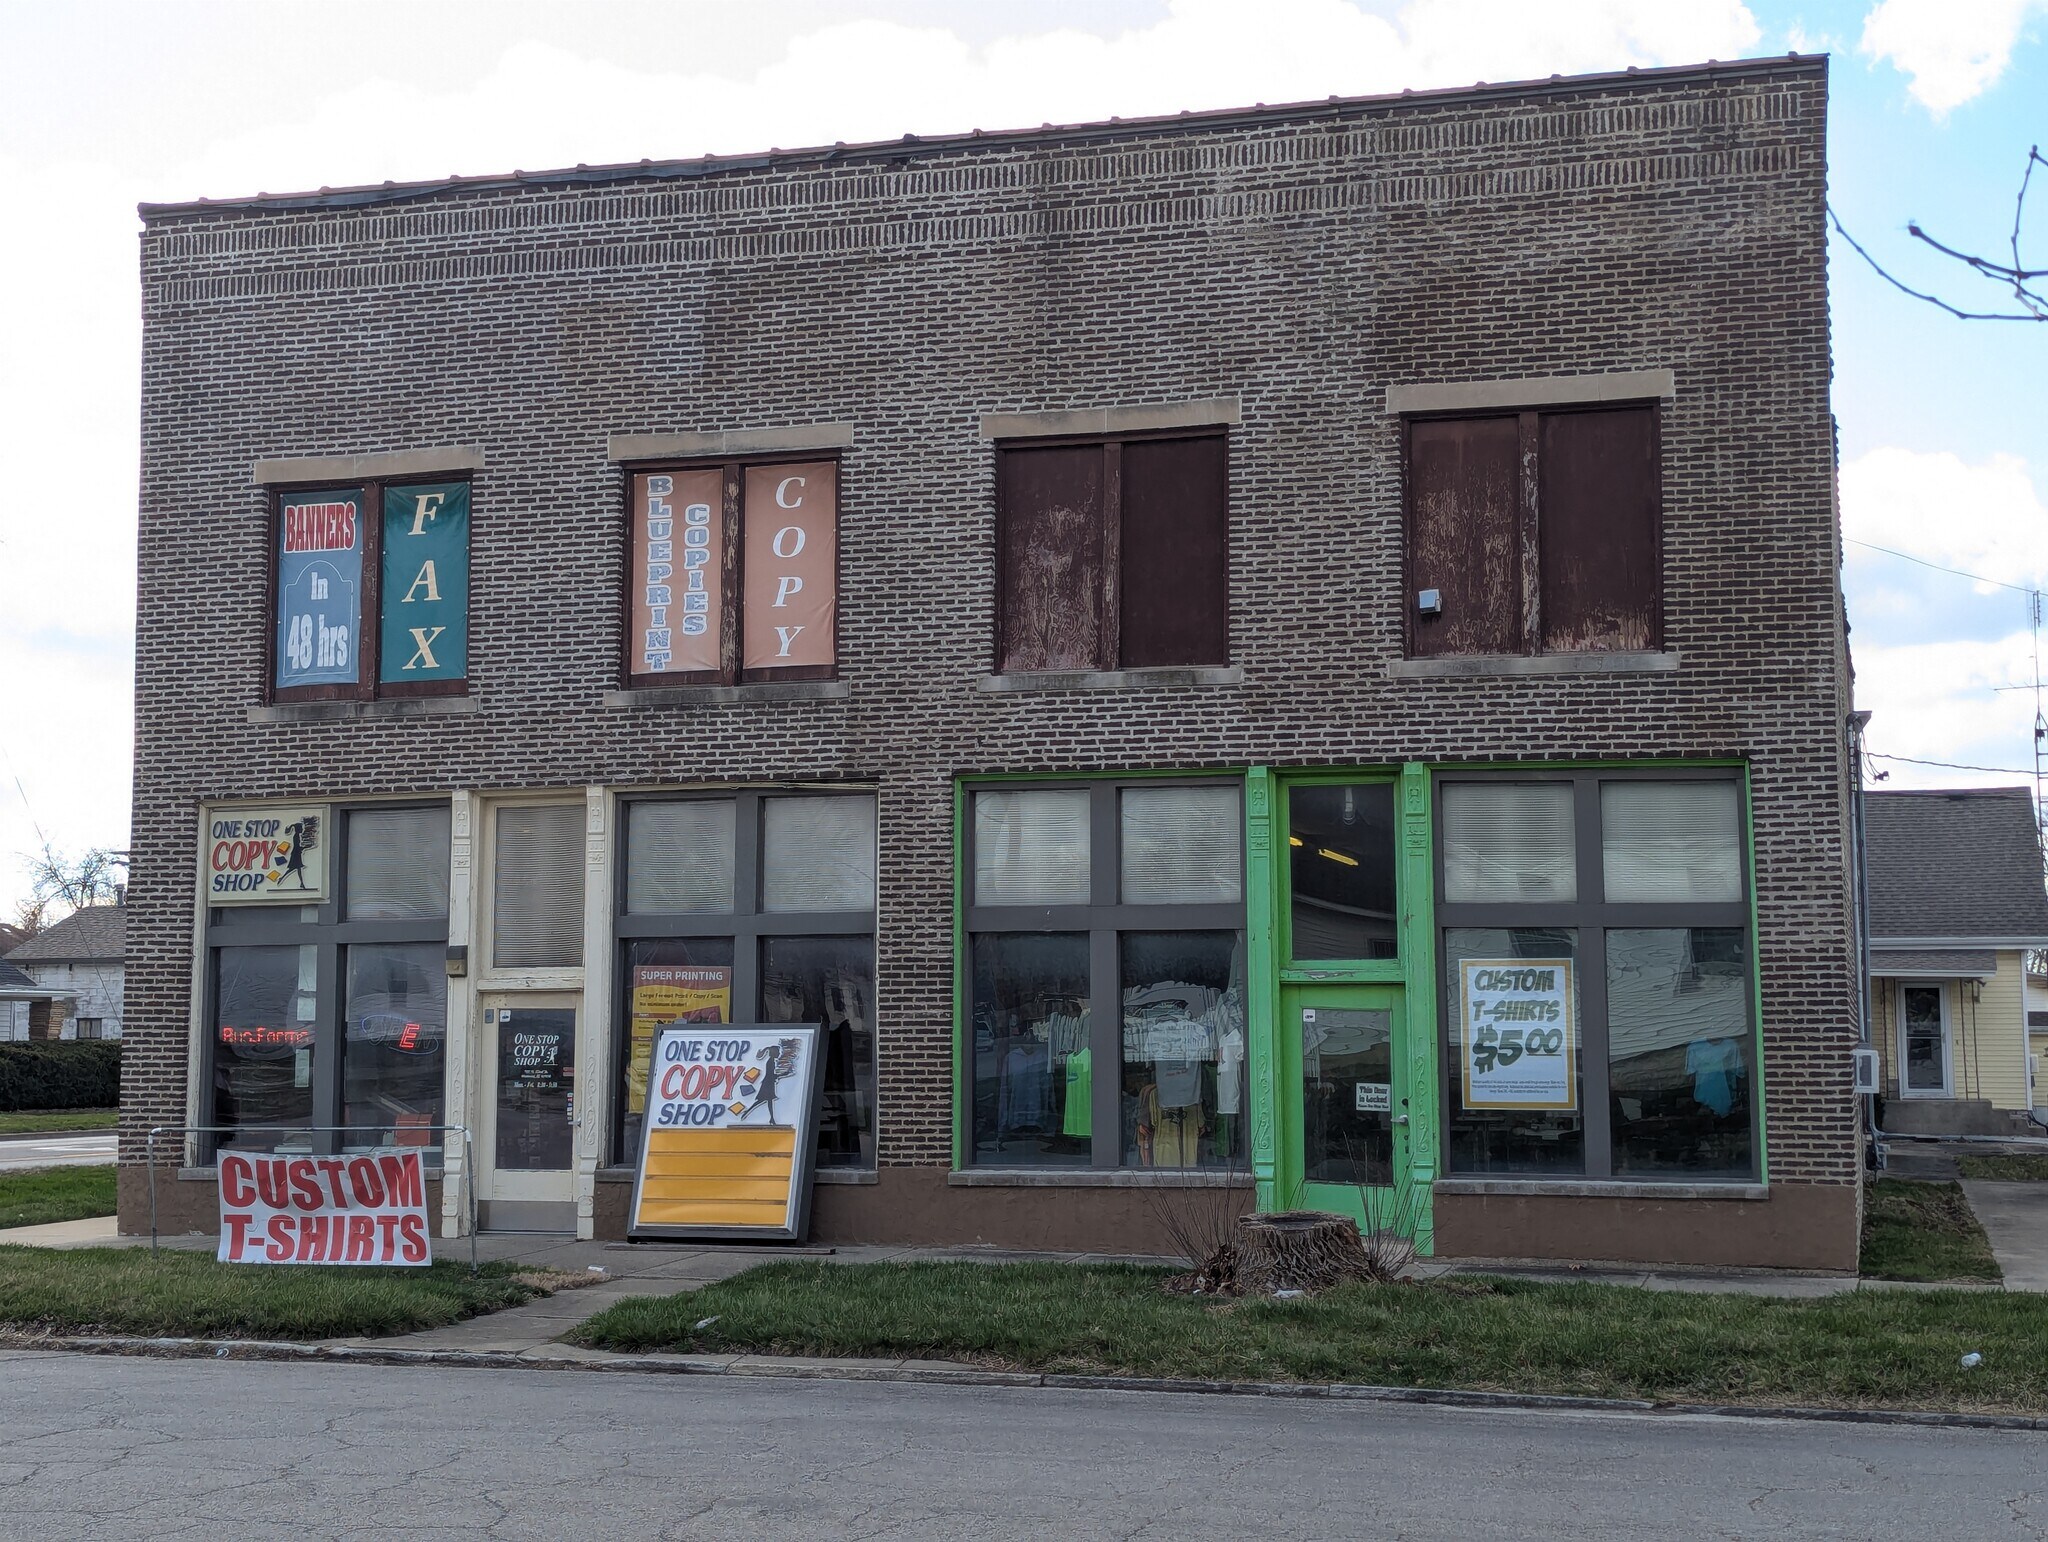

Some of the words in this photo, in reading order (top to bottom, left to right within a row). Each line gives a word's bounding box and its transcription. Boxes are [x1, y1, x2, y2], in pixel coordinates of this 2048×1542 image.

[284, 501, 356, 553] BANNERS
[644, 476, 673, 671] BLUEPRINT
[682, 504, 710, 635] COPIES
[772, 476, 806, 657] COPY
[311, 572, 329, 600] In
[401, 493, 446, 670] FAX
[287, 614, 313, 669] 48
[317, 614, 348, 667] hrs
[213, 820, 242, 839] ONE
[244, 819, 280, 838] STOP
[212, 840, 278, 871] COPY
[213, 873, 265, 892] SHOP
[641, 971, 672, 980] SUPER
[675, 971, 723, 980] PRINTING
[1474, 969, 1555, 992] CUSTOM
[1472, 1000, 1560, 1022] T-SHIRTS
[514, 1033, 535, 1044] ONE
[536, 1035, 559, 1044] STOP
[514, 1045, 547, 1057] COPY
[665, 1040, 703, 1062] ONE
[704, 1040, 751, 1062] STOP
[514, 1057, 541, 1066] SHOP
[661, 1064, 745, 1100] COPY
[1359, 1085, 1373, 1093] This
[658, 1103, 726, 1126] SHOP
[222, 1153, 422, 1211] CUSTOM
[224, 1214, 427, 1262] T-SHIRTS
